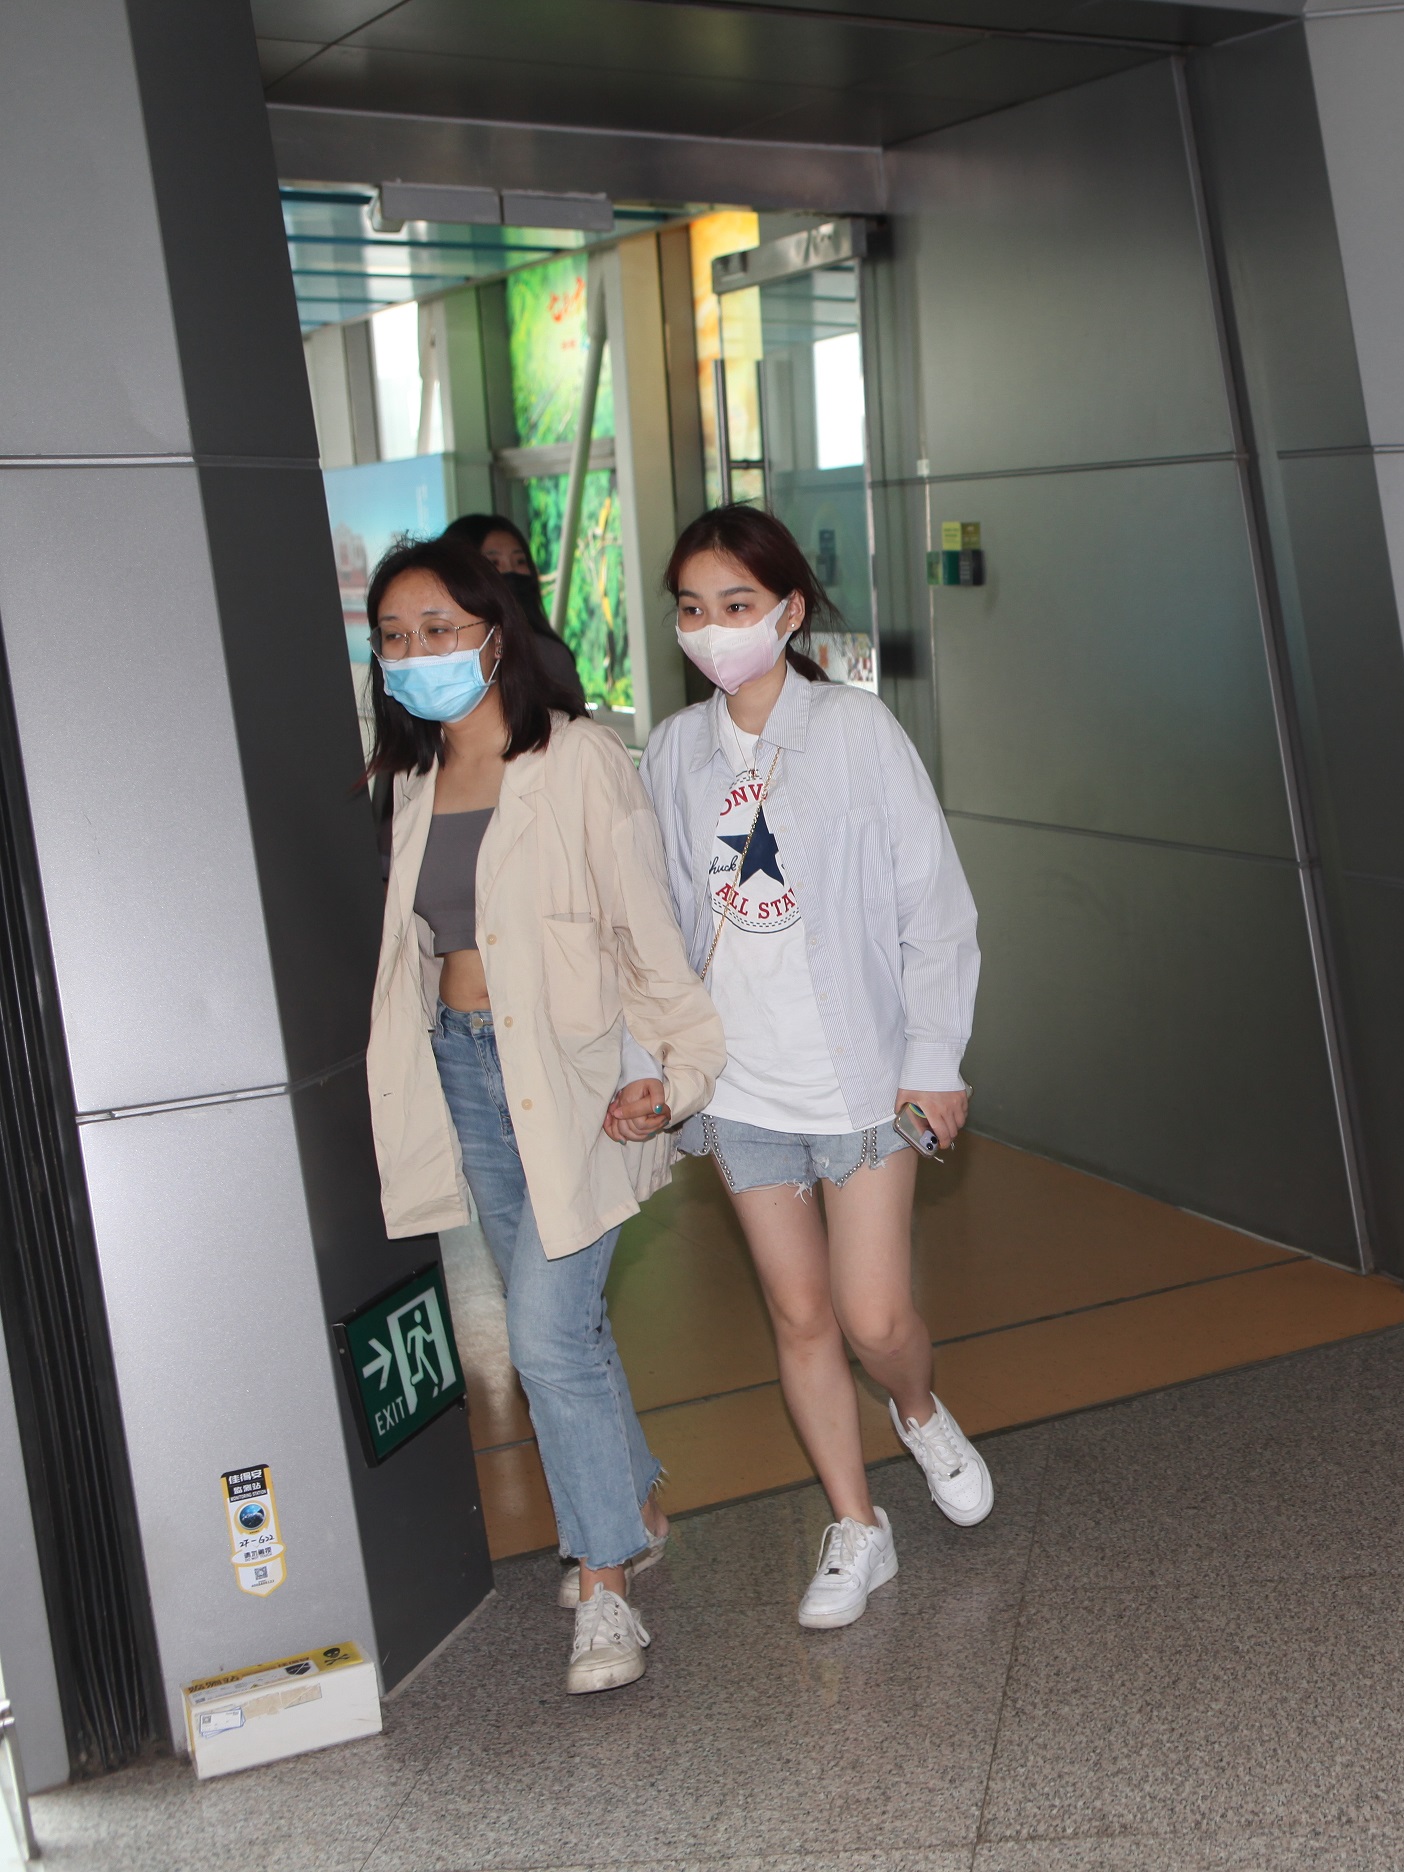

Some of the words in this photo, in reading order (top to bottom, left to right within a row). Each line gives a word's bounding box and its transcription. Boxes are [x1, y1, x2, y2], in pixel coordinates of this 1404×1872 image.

[708, 854, 738, 875] huck
[715, 882, 749, 916] ALL
[374, 1395, 405, 1436] EXIT
